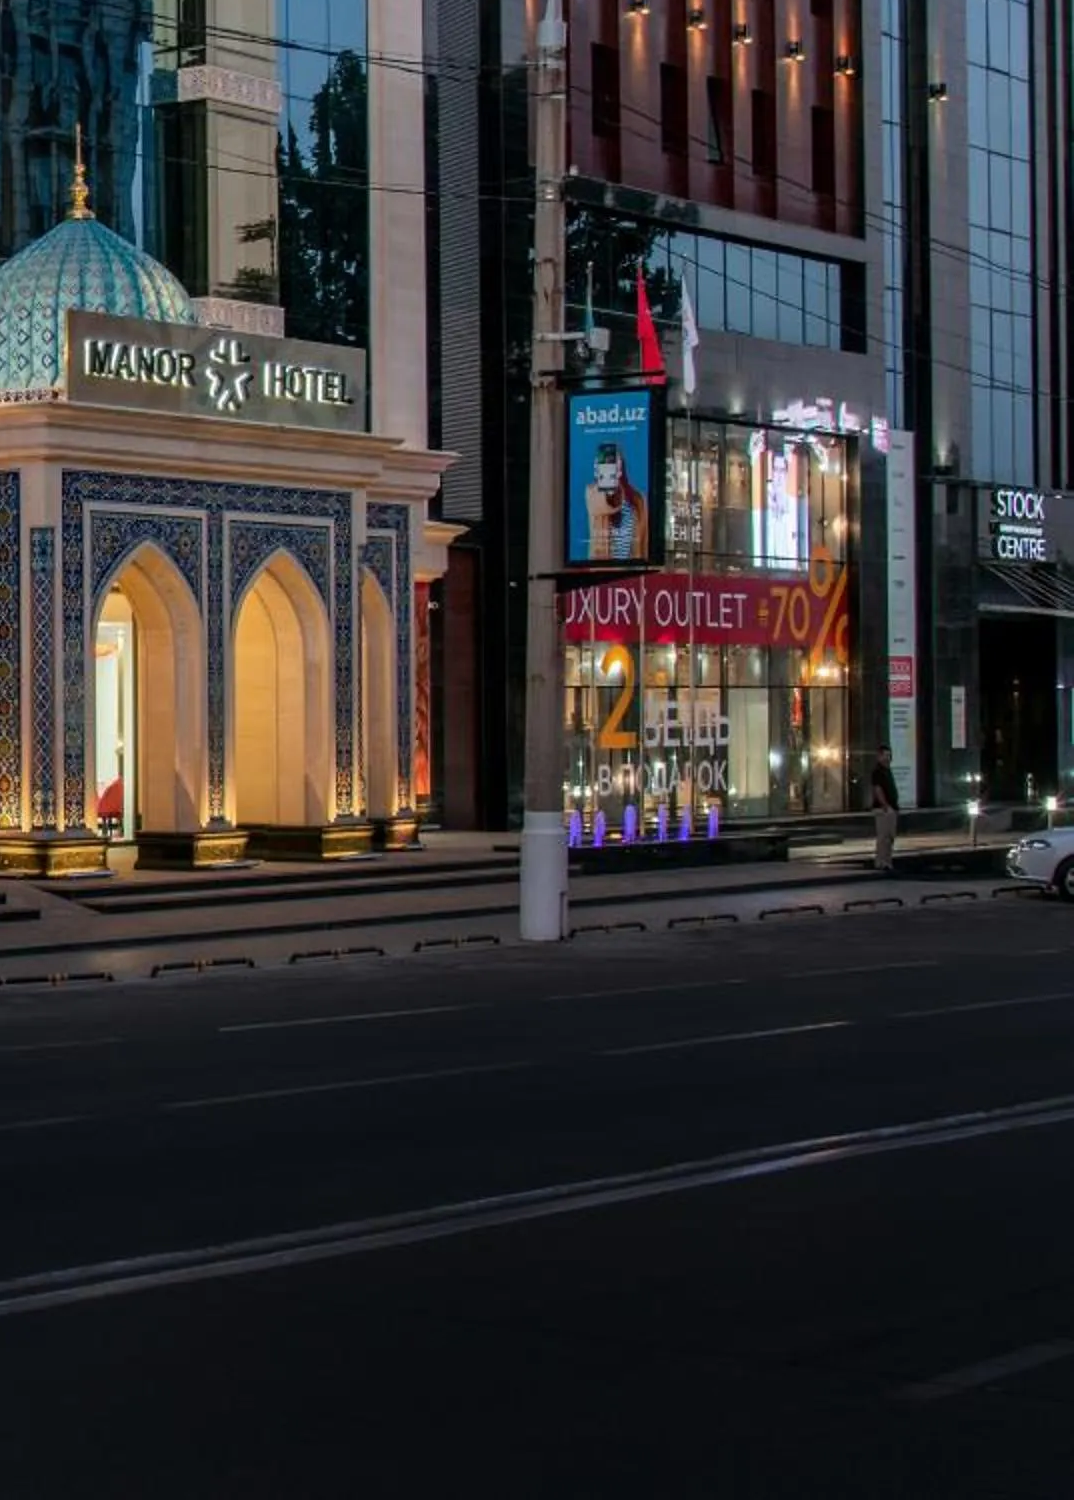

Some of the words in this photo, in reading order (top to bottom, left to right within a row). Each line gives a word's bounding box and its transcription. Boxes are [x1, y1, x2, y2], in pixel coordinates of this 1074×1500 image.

[84, 339, 196, 387] MANOR
[263, 361, 353, 404] HOTEL
[576, 403, 646, 425] abad.uz
[997, 489, 1045, 520] STOCK
[997, 535, 1046, 561] CENTRE
[566, 587, 646, 625] UXURY
[654, 589, 748, 628] OUTLET
[599, 644, 637, 748] 2
